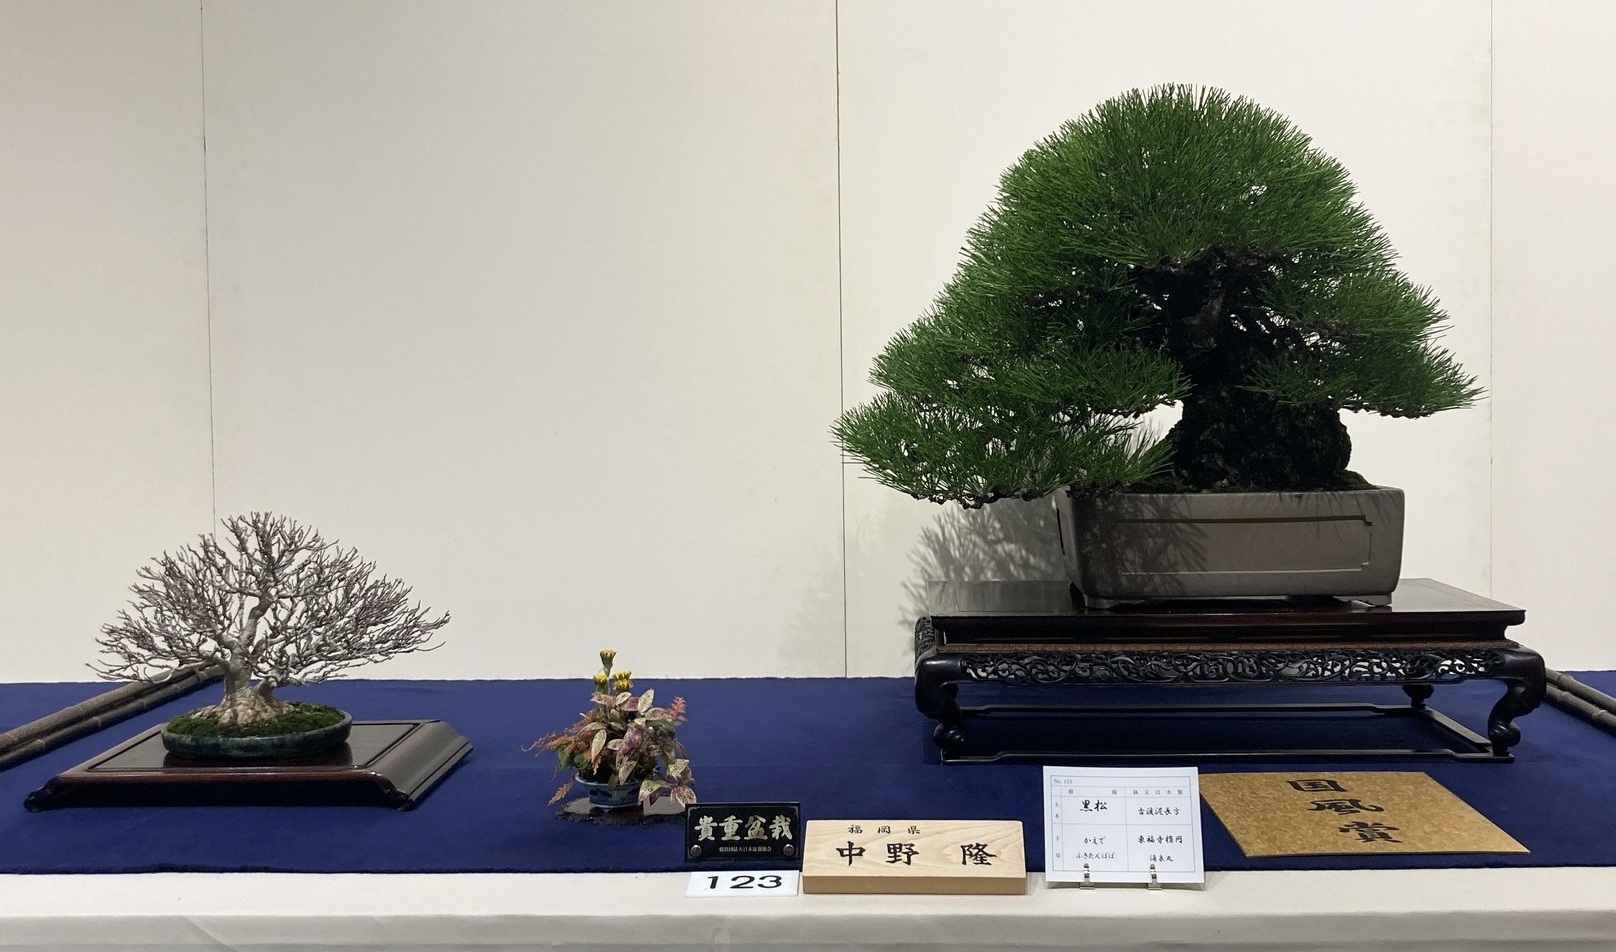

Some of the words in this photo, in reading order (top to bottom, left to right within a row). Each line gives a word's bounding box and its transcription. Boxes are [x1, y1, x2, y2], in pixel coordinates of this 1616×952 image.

[1080, 799, 1108, 812] 黒松
[1287, 778, 1403, 844] 国風賞
[694, 815, 793, 841] 貴重盆栽
[848, 824, 921, 834] 福岡県
[1084, 836, 1106, 845] かえで
[707, 875, 783, 889] 123
